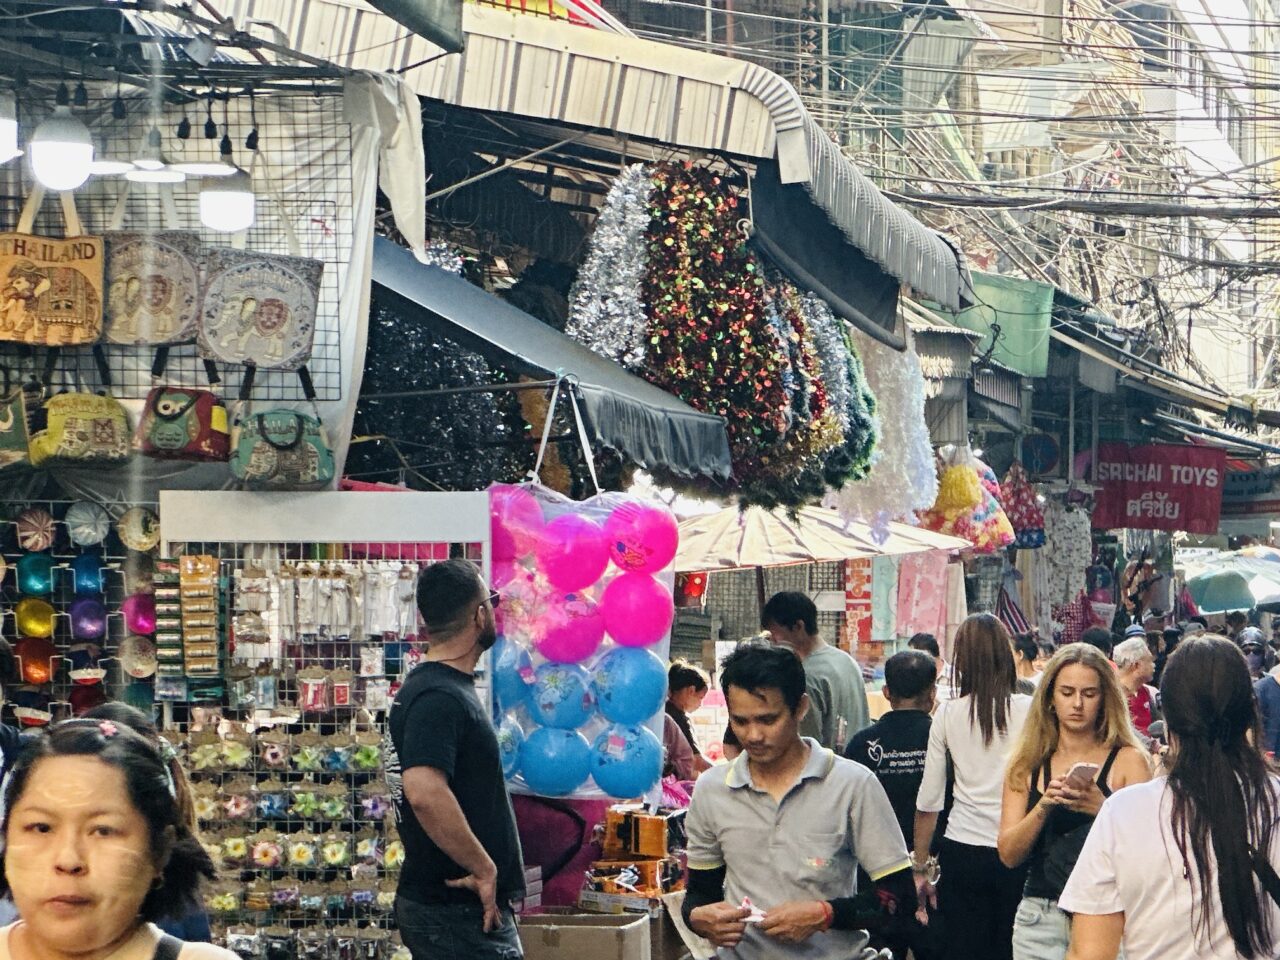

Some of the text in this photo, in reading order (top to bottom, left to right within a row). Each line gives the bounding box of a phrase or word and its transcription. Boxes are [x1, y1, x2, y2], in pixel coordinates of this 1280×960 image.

[1, 238, 96, 262] THAILAND
[1099, 462, 1219, 487] SRICHAI TOYS
[1126, 491, 1180, 519] ศรีชัย
